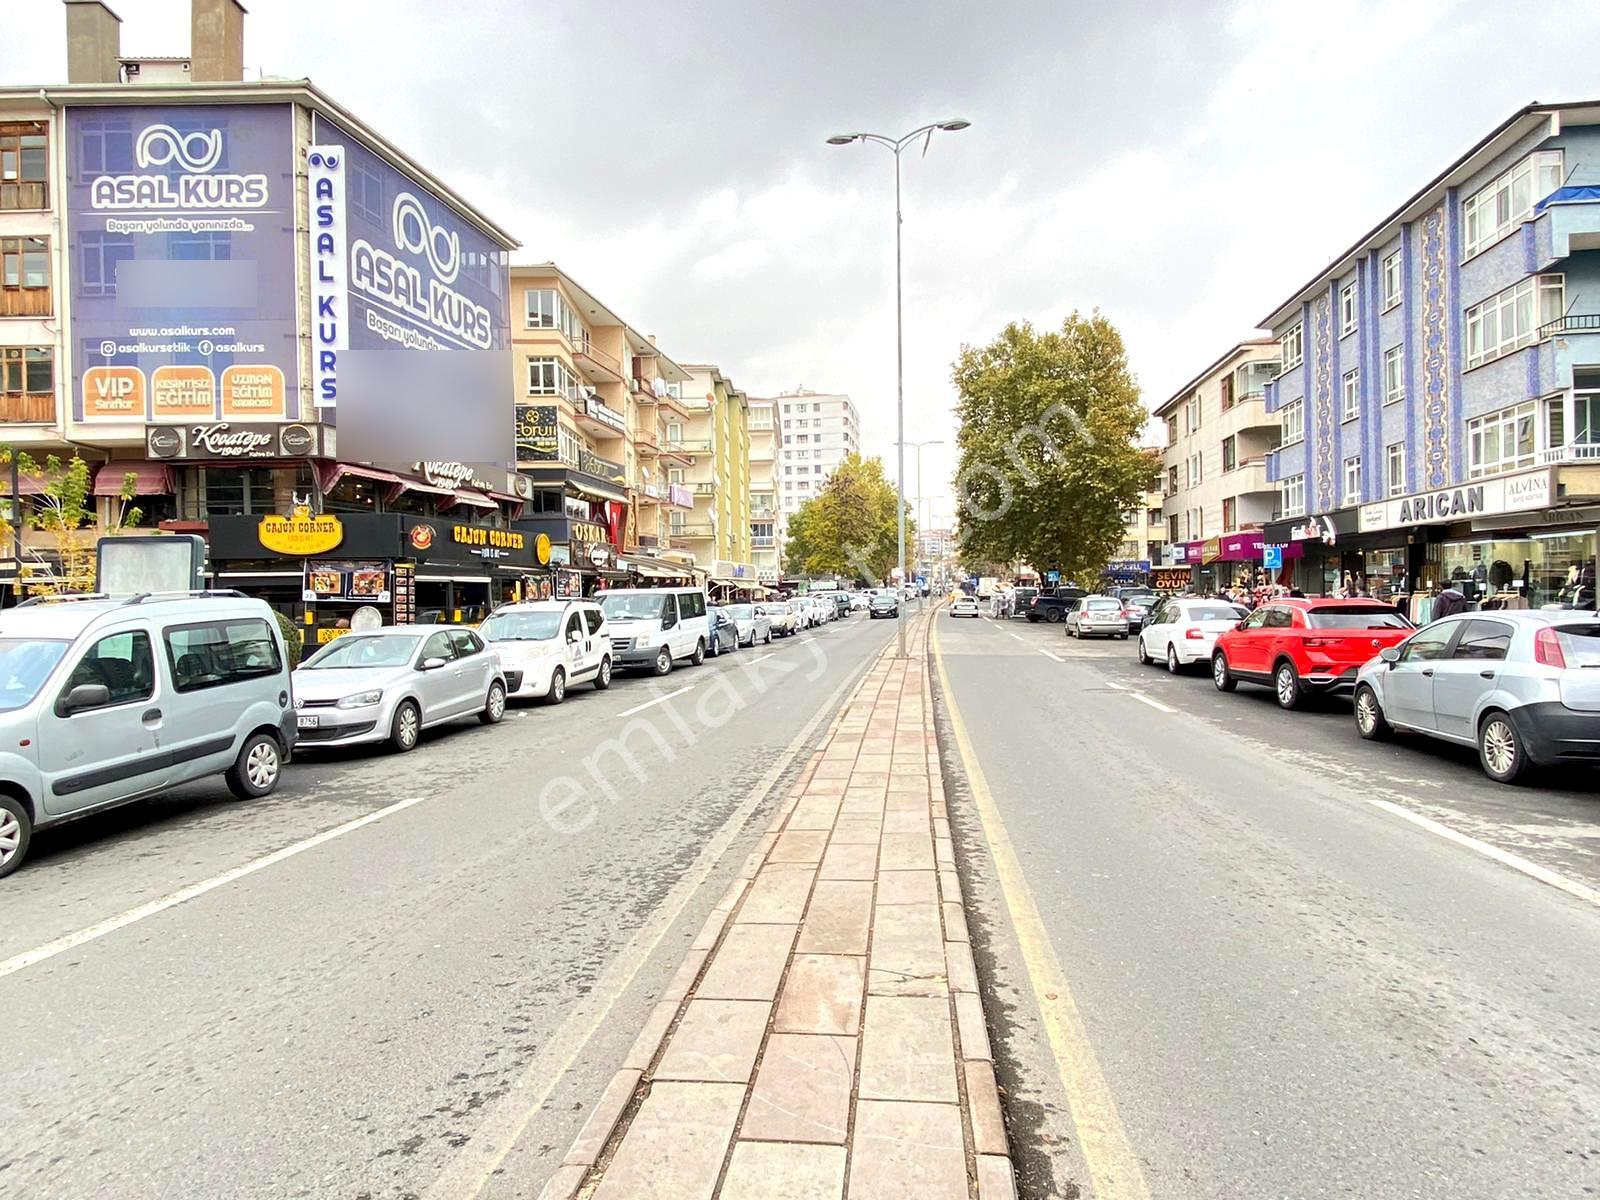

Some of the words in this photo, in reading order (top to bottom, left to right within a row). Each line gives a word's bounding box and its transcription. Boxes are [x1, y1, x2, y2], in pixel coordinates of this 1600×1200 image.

[92, 176, 179, 208] ASAL
[179, 175, 268, 207] KURS
[107, 219, 144, 234] Başarı
[146, 218, 189, 233] yolunda
[316, 177, 335, 281] ASAL
[352, 240, 431, 320] ASAL
[430, 279, 491, 348] KURS
[129, 325, 236, 337] www.asalkurs.com
[367, 309, 403, 341] Başarı
[118, 342, 191, 353] asalkursetlik
[215, 342, 265, 353] asalkurs
[318, 295, 336, 399] KURS
[95, 377, 134, 398] VIP
[231, 374, 273, 385] UZMAN
[156, 389, 211, 406] EĞİTİM
[231, 385, 273, 398] EĞİTİM
[192, 423, 272, 453] Kocatepe
[220, 446, 244, 457] 1949
[1399, 485, 1485, 524] ARICAN
[265, 522, 296, 533] CAJUN
[298, 522, 336, 533] CORNER
[575, 522, 607, 543] OSKAR
[453, 525, 487, 545] CAJUN
[489, 530, 524, 549] CORNER
[197, 566, 205, 576] 2
[1157, 570, 1190, 580] SEVİN
[1156, 580, 1187, 588] OYUN
